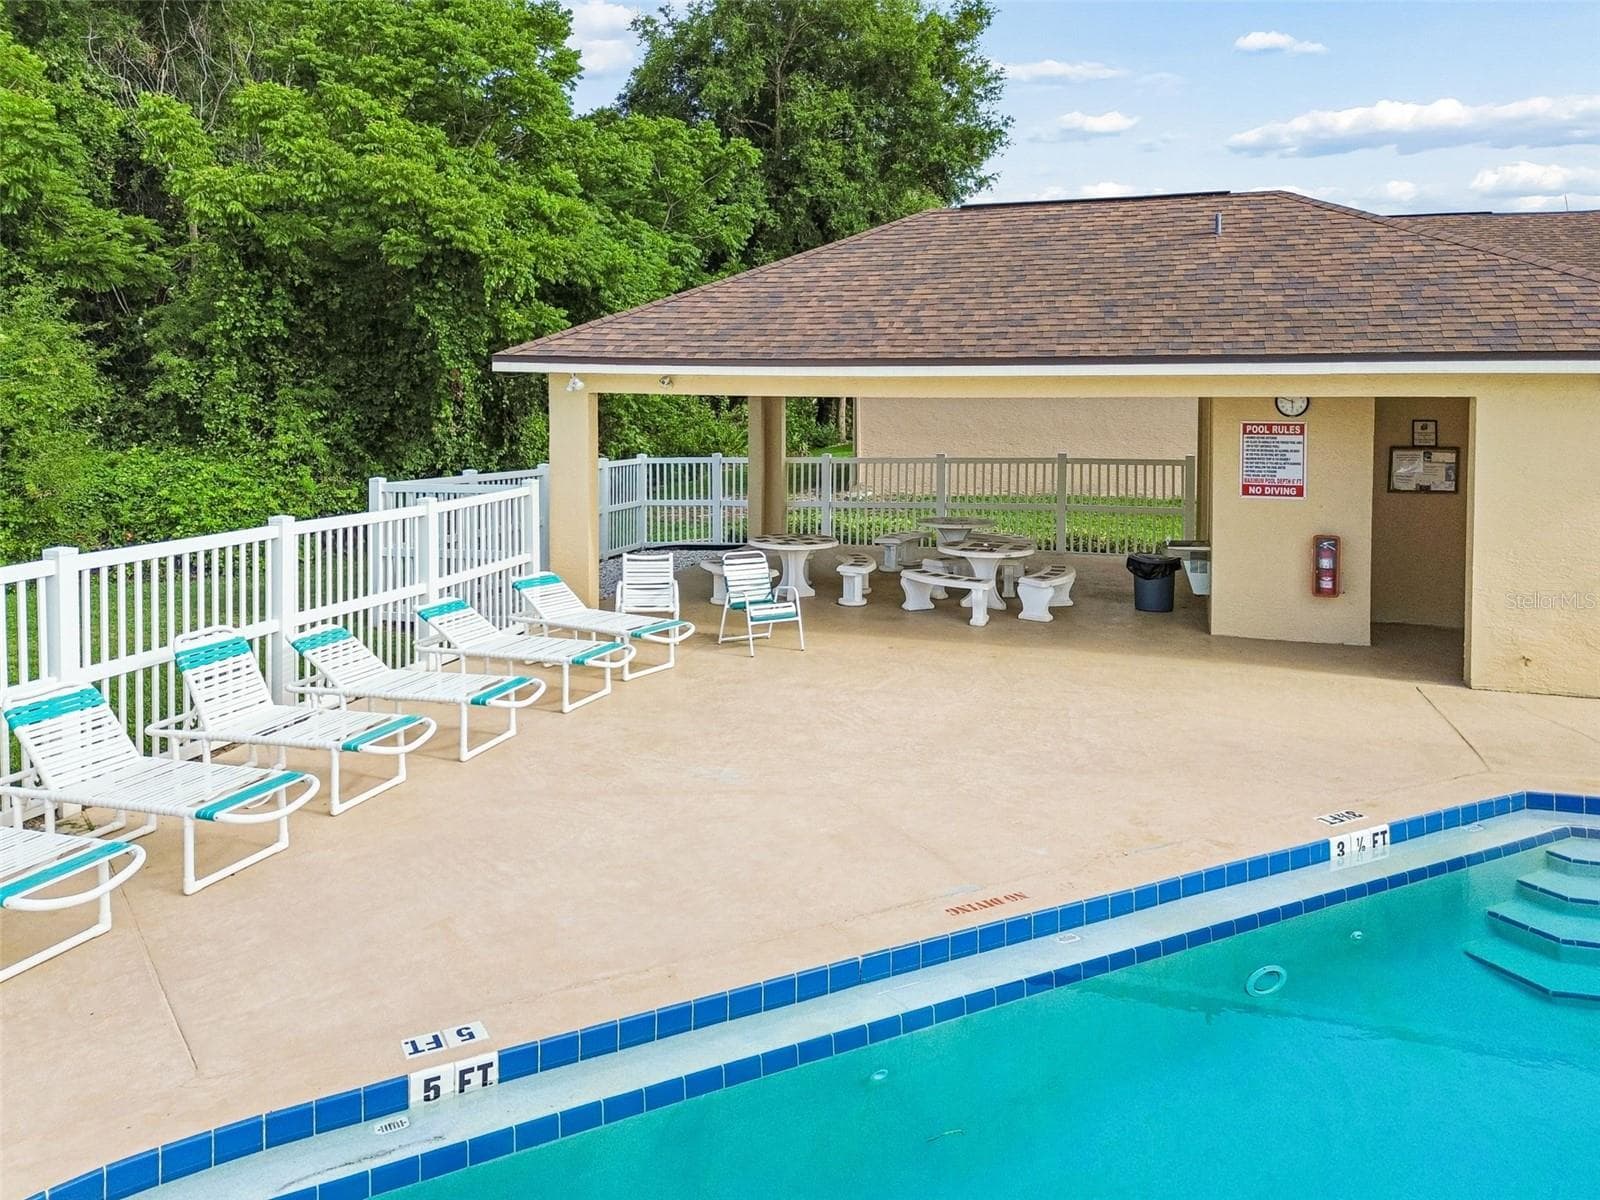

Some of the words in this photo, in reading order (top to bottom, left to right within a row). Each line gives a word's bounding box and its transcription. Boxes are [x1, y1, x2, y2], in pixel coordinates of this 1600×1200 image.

[1246, 425, 1269, 434] POOL
[1272, 425, 1301, 434] RULES
[1248, 486, 1262, 495] NO
[1264, 486, 1297, 496] DIVING
[1337, 841, 1345, 857] 3
[1372, 830, 1388, 849] FT
[456, 1026, 476, 1042] 5
[423, 1075, 441, 1102] 5
